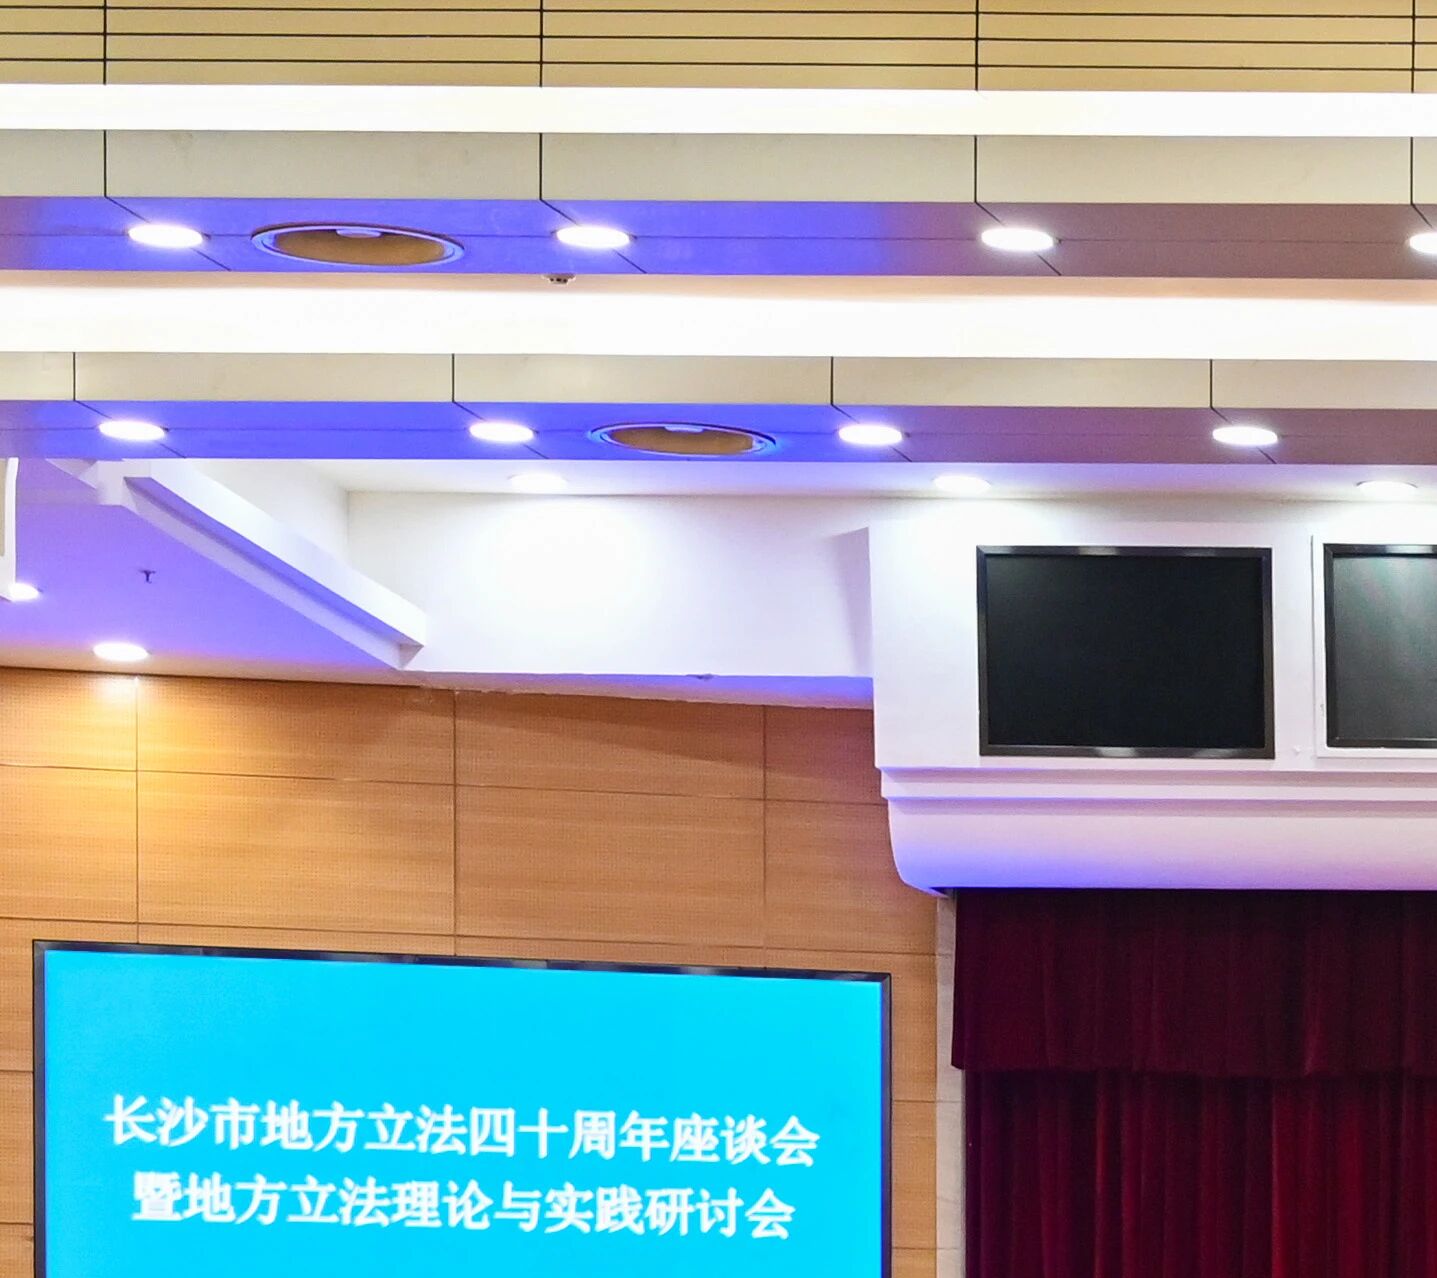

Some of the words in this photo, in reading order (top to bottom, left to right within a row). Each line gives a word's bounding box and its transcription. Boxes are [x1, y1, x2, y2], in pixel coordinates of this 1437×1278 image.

[104, 1094, 820, 1168] 长沙市地方立法四十周年座谈会
[132, 1171, 796, 1240] 暨地方立法理论与实践研讨会
